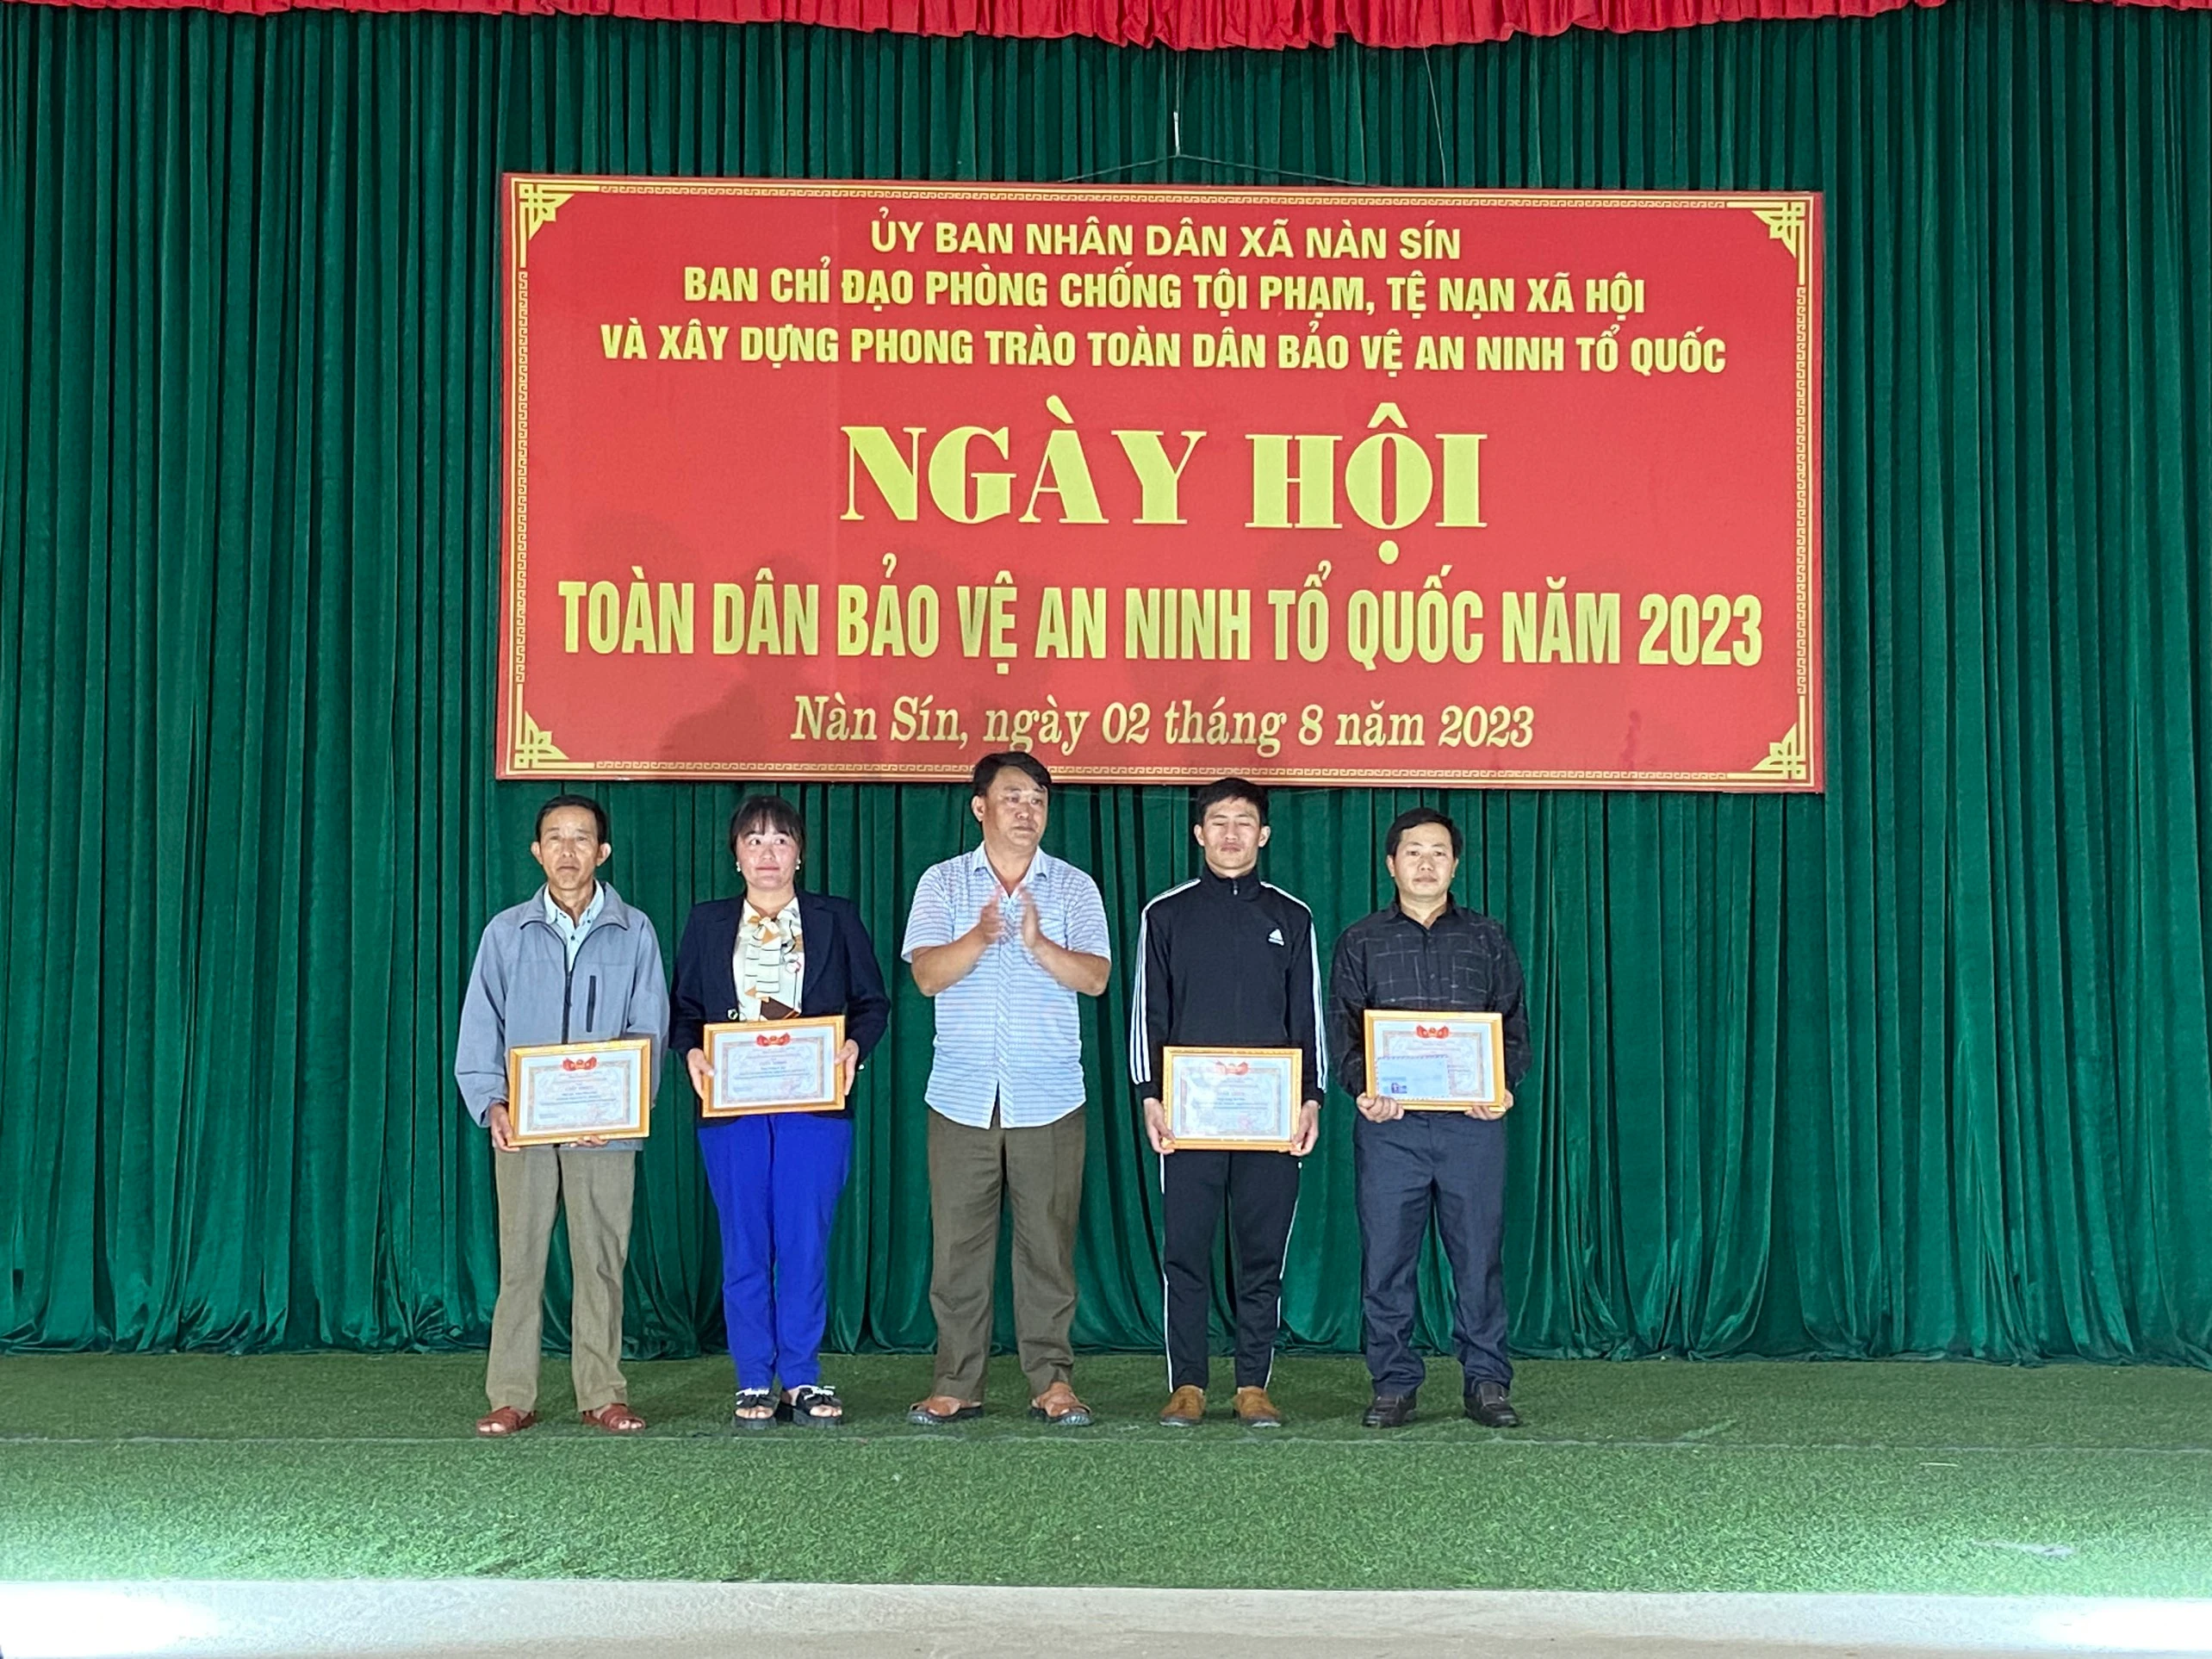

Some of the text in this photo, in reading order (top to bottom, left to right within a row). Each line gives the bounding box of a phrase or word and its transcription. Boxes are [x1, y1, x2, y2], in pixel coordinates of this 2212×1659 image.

[871, 206, 1460, 260] ỦY BAN NHÂN DÂN XÃ NÀN SÍN
[684, 255, 1645, 321] BAN CHỈ ĐẠO PHÒNG CHỐNG TỘI PHẠM, TỆ NẠN XÃ HỘI
[600, 317, 1726, 378] VÀ XÂY DỰNG PHONG TRÀO TOÀN DÂN BẢO VỆ AN NINH TỔ QUỐC
[840, 395, 1488, 565] NGÀY HỘI
[557, 552, 1762, 674] TOÀN DÂN BẢO VỆ AN NINH TỔ QUỐC NĂM 2023
[790, 691, 1535, 758] Nàn Sín, ngày 02 tháng 8 năm 2023
